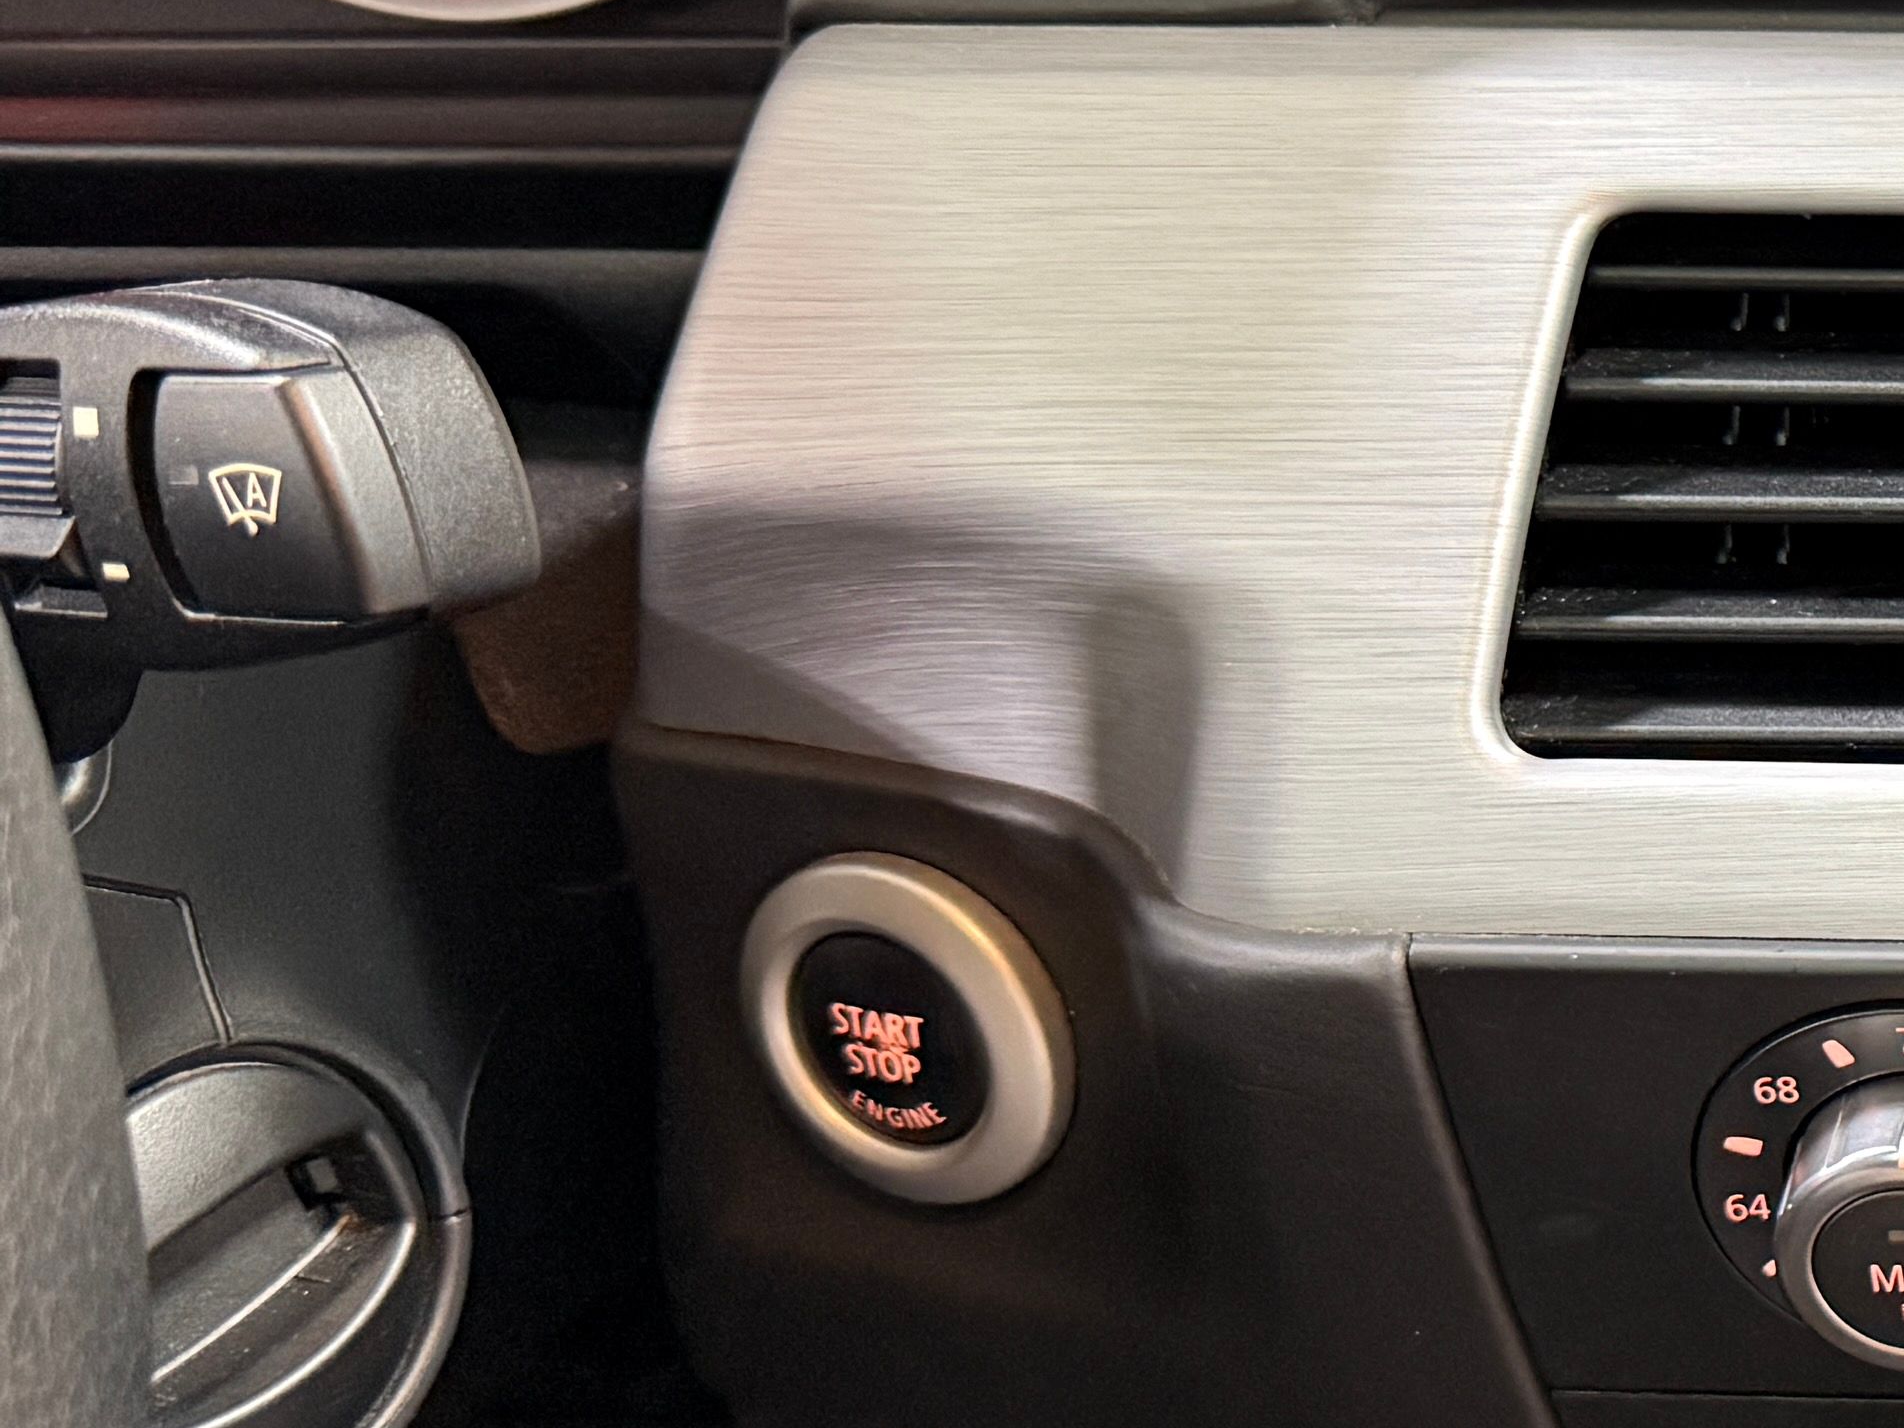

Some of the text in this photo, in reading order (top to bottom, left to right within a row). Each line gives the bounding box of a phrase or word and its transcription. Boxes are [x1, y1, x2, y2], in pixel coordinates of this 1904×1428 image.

[829, 1002, 924, 1049] START
[842, 1043, 922, 1084] STOP
[851, 1089, 948, 1129] ENGINE
[1753, 1076, 1800, 1105] 68
[1724, 1194, 1771, 1222] 64
